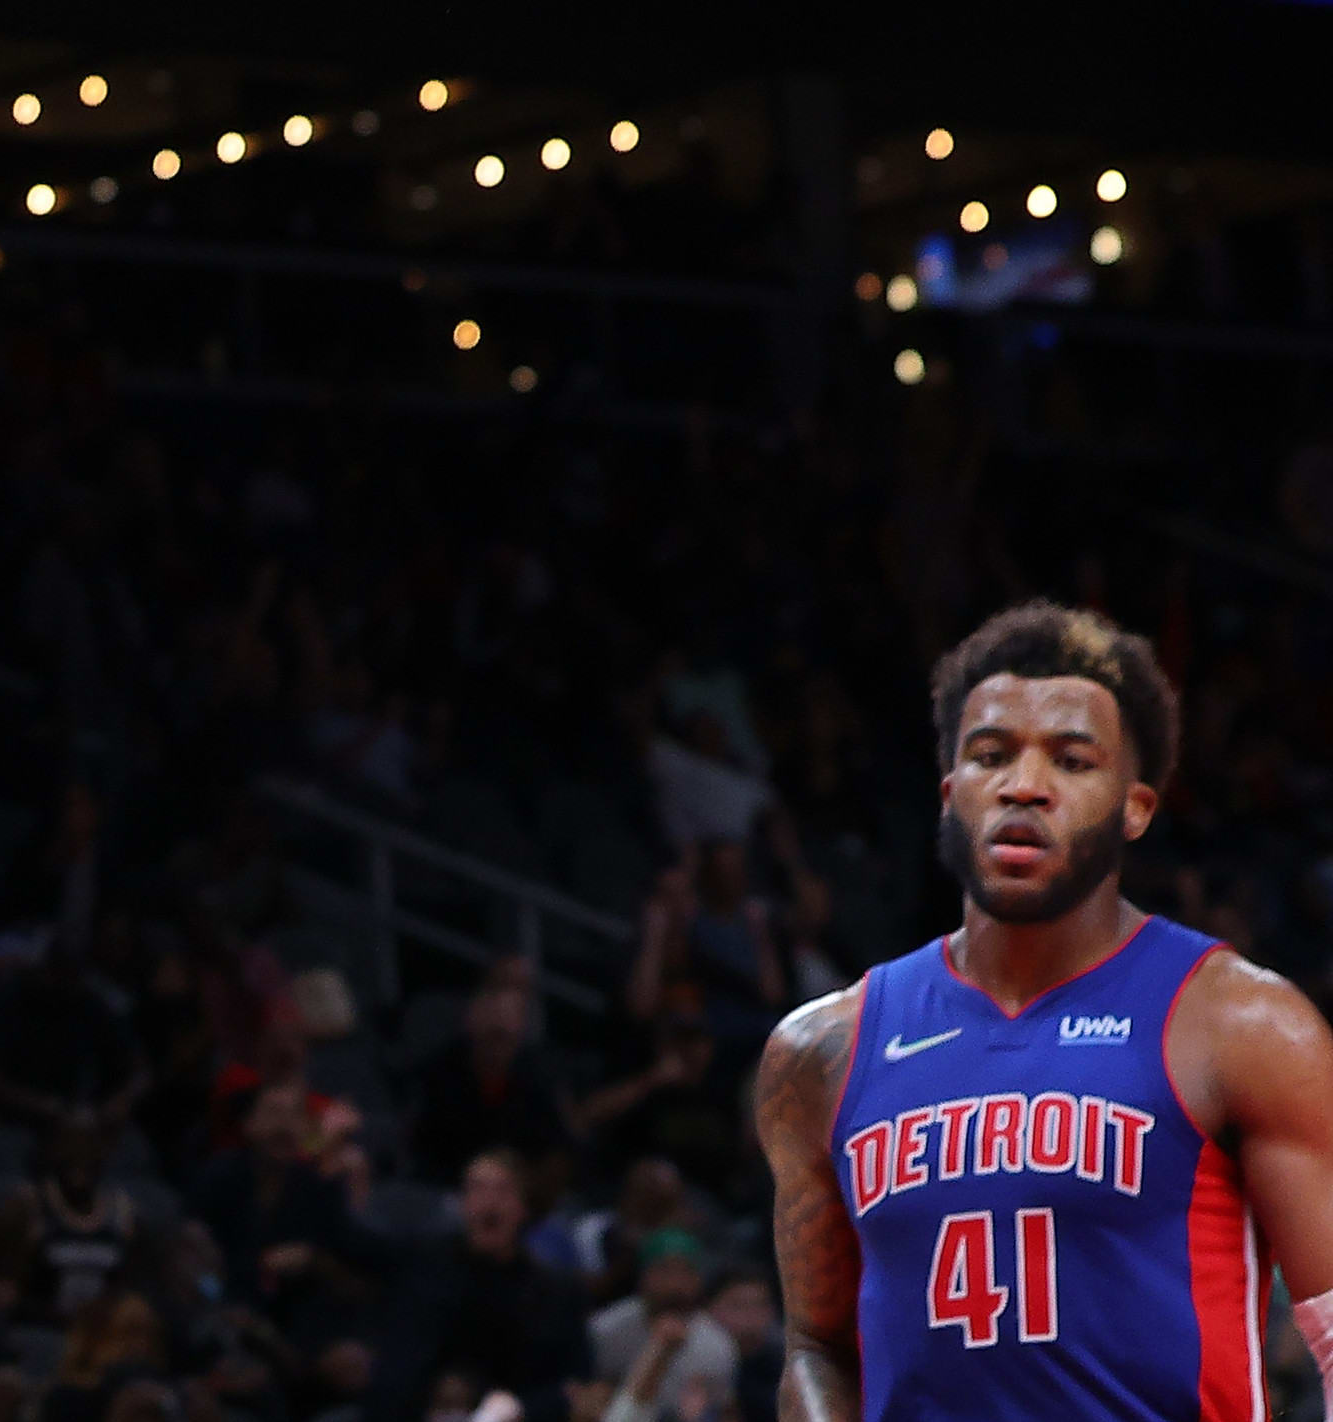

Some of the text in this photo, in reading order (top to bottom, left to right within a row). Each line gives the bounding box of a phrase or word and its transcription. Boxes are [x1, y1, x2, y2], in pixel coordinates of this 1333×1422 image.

[1059, 1015, 1132, 1039] UWM
[845, 1091, 1155, 1217] DETROIT
[927, 1207, 1058, 1349] 41
